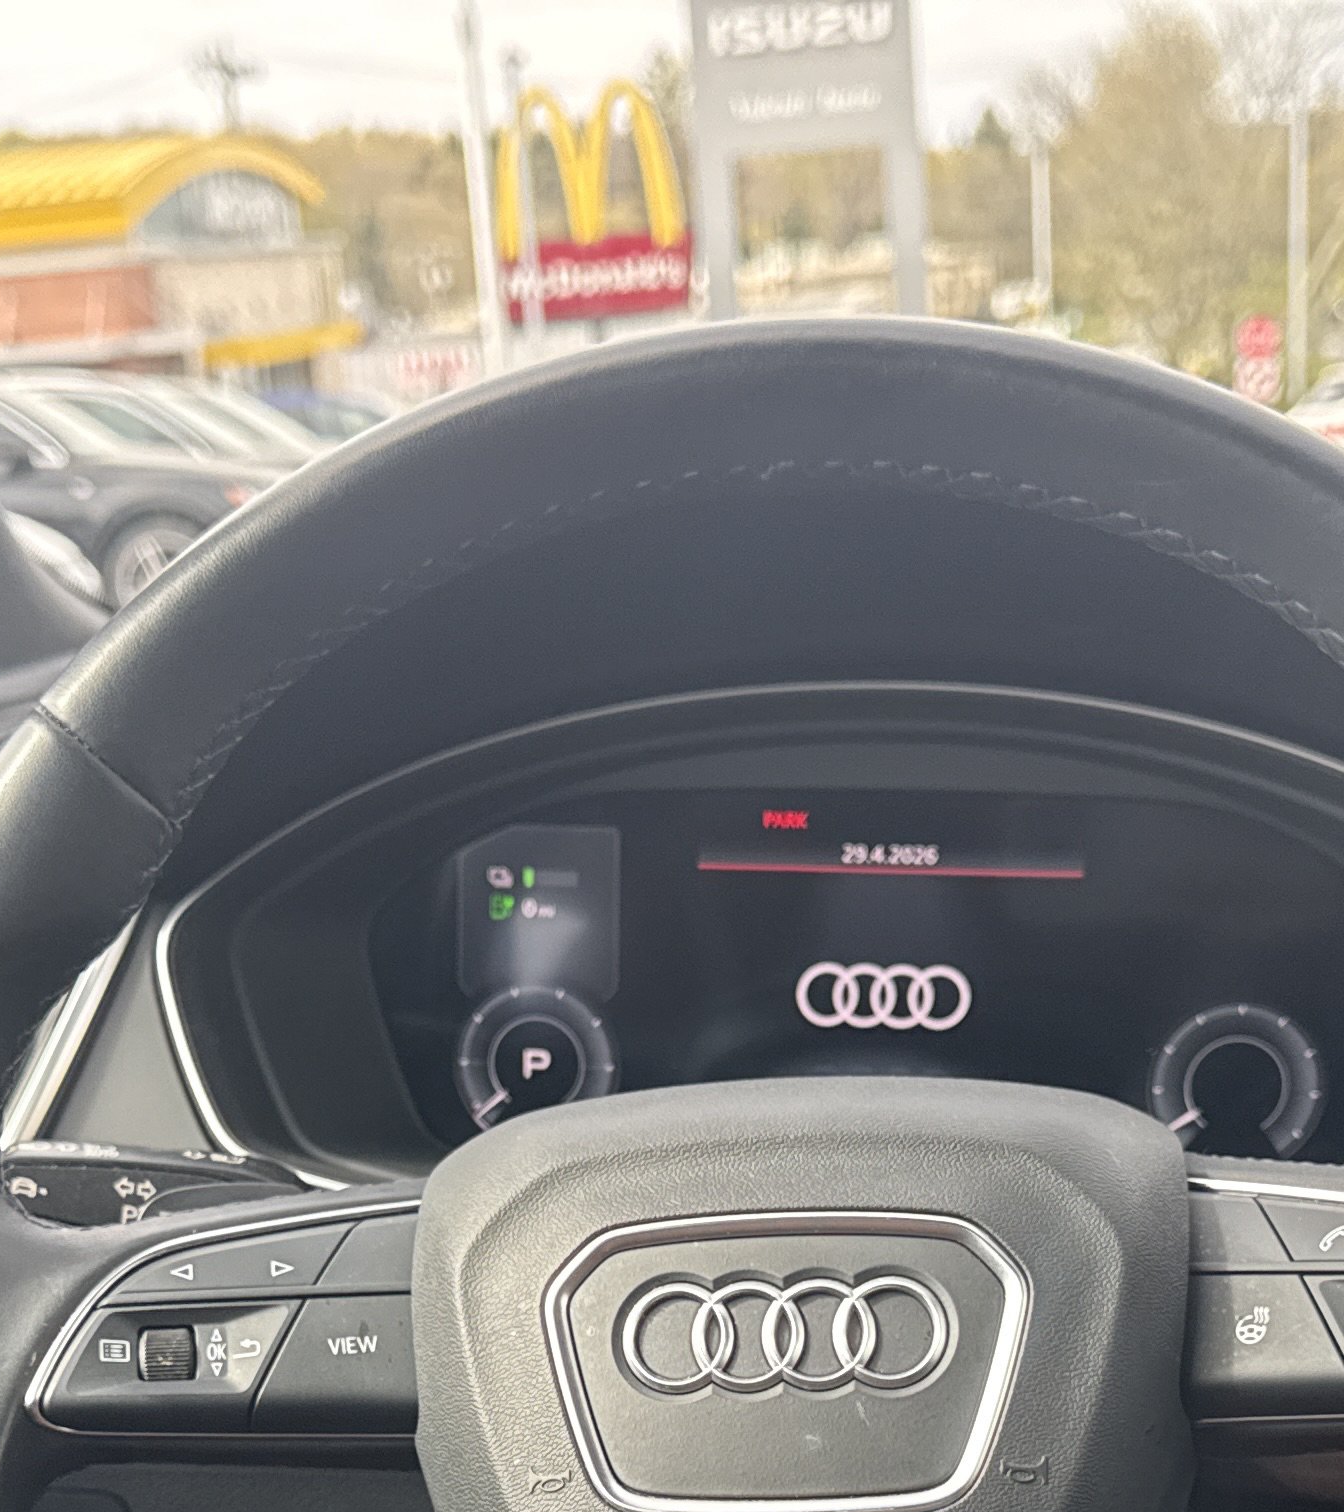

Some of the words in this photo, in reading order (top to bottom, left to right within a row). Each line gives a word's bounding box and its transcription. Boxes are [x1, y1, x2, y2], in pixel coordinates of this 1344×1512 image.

[707, 1, 893, 56] ISUZU
[762, 810, 808, 829] PARK
[522, 1048, 551, 1080] P
[207, 1343, 226, 1361] OK
[327, 1335, 378, 1356] VIEW
